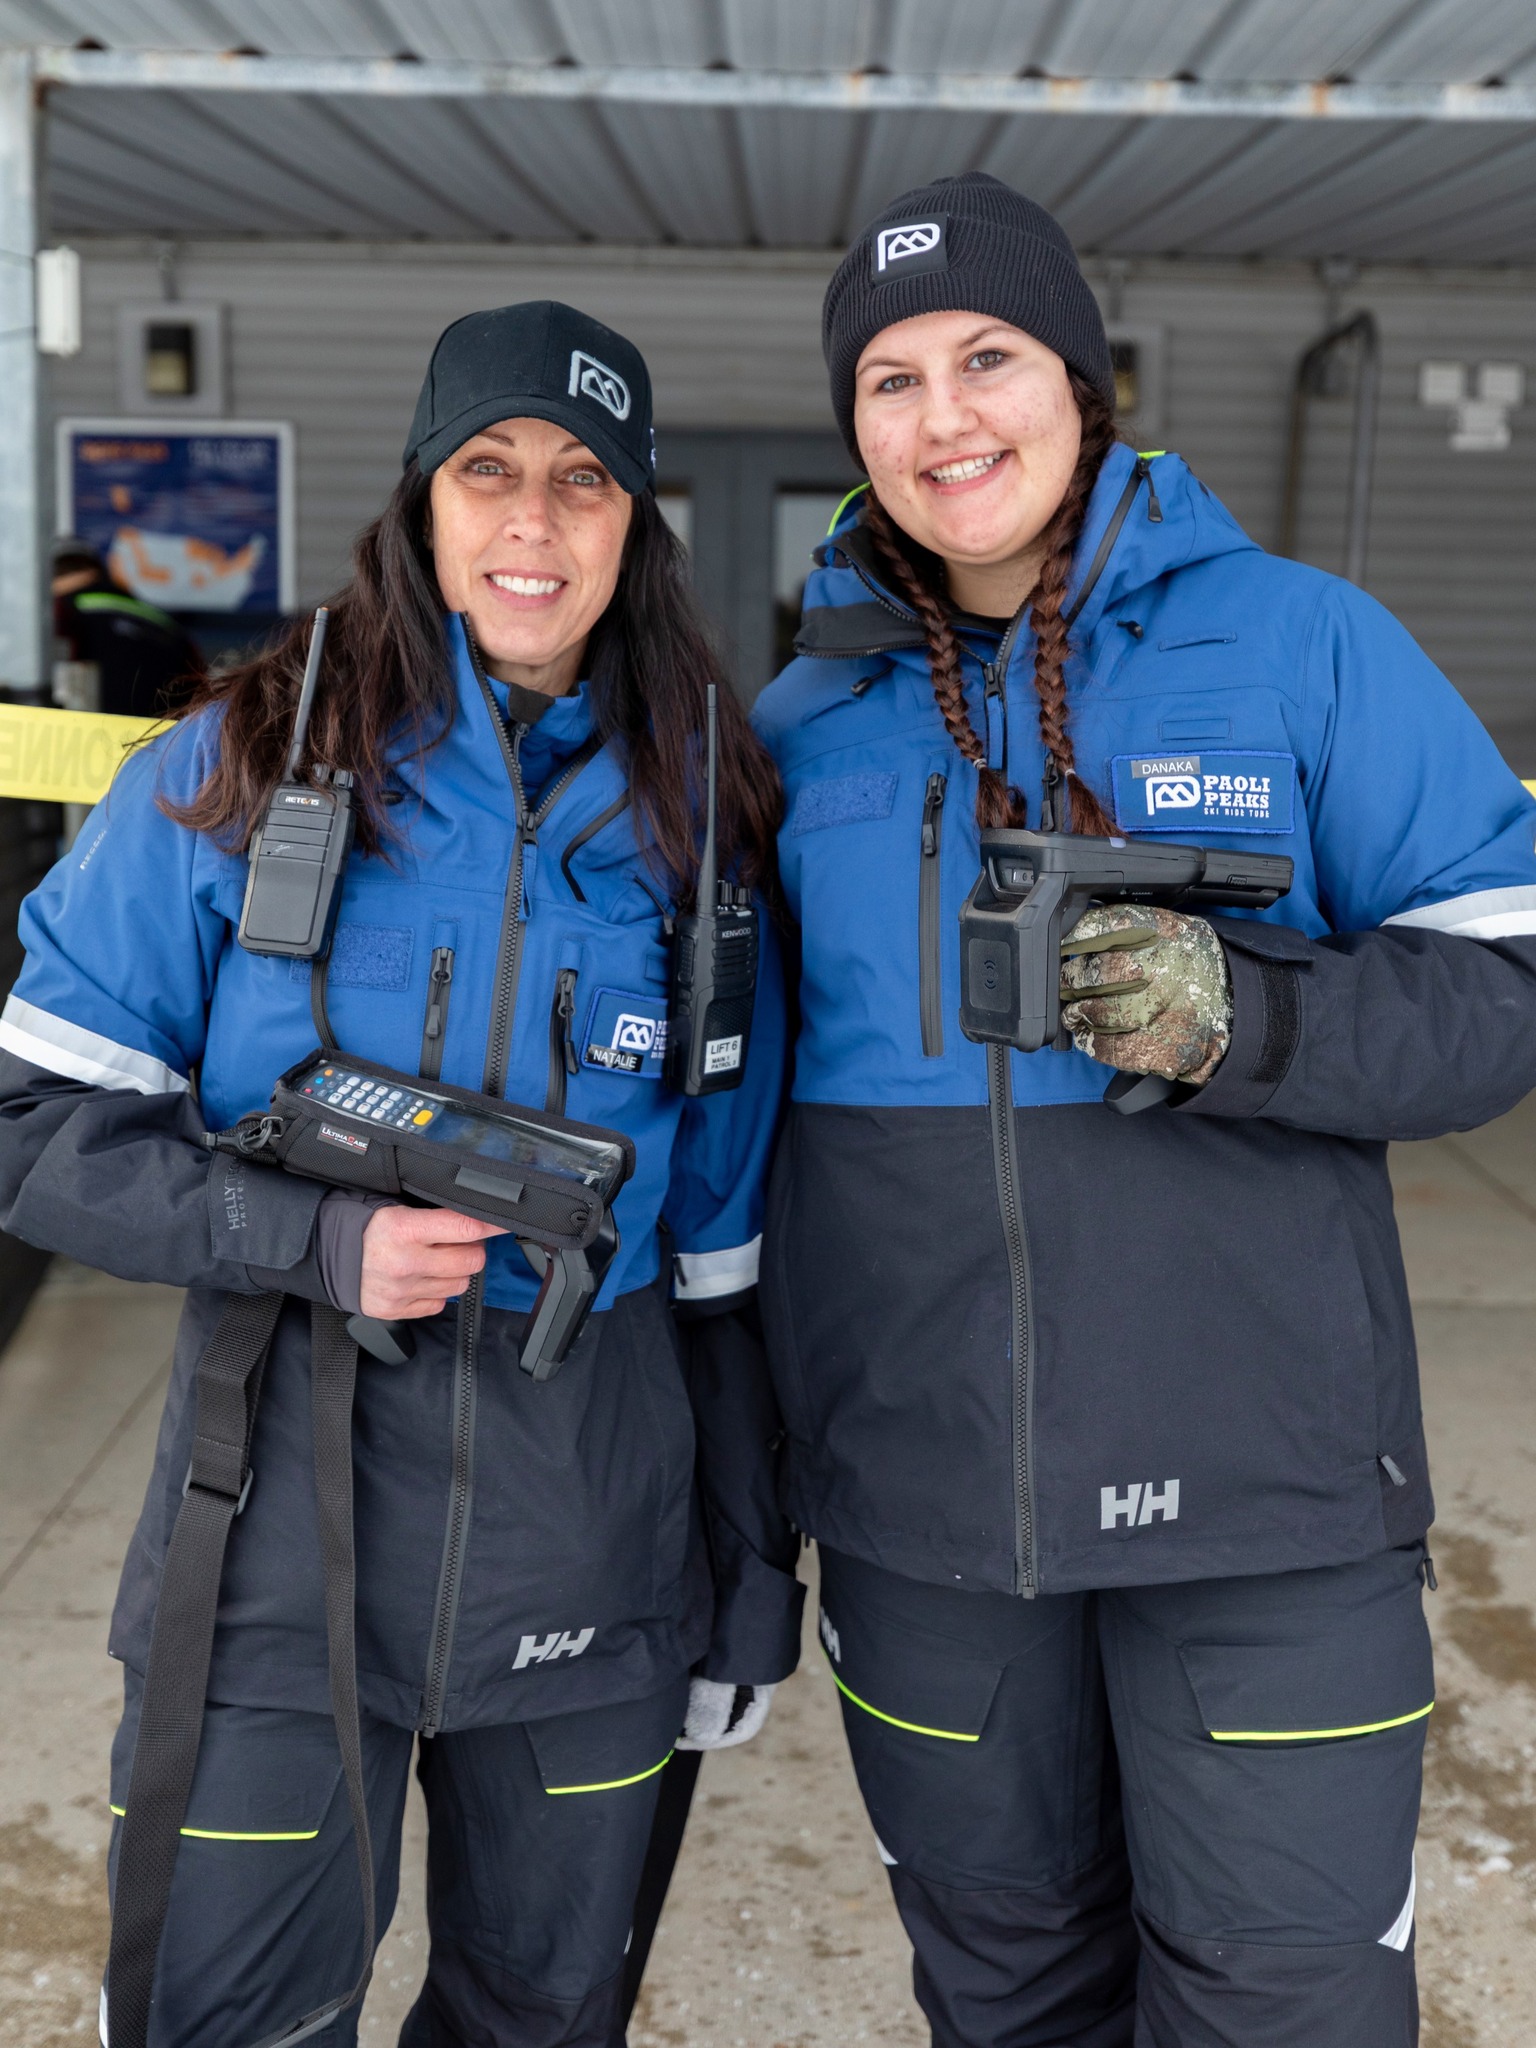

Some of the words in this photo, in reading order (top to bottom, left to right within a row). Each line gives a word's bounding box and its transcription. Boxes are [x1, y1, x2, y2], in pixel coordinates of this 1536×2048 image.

[1142, 761, 1193, 775] DANAKA
[1203, 775, 1270, 793] PAOLI
[1204, 791, 1269, 809] PEAKS
[1204, 807, 1219, 815] SKI
[1249, 809, 1269, 818] TUBE
[722, 927, 751, 939] KENWOOD
[711, 1042, 730, 1054] LIFT
[731, 1040, 738, 1051] 6
[593, 1049, 637, 1069] NATALIE
[711, 1061, 732, 1070] PATROL
[712, 1056, 726, 1064] MAIN
[224, 1186, 241, 1230] HELLY
[1101, 1479, 1180, 1530] HH
[512, 1627, 596, 1670] HH
